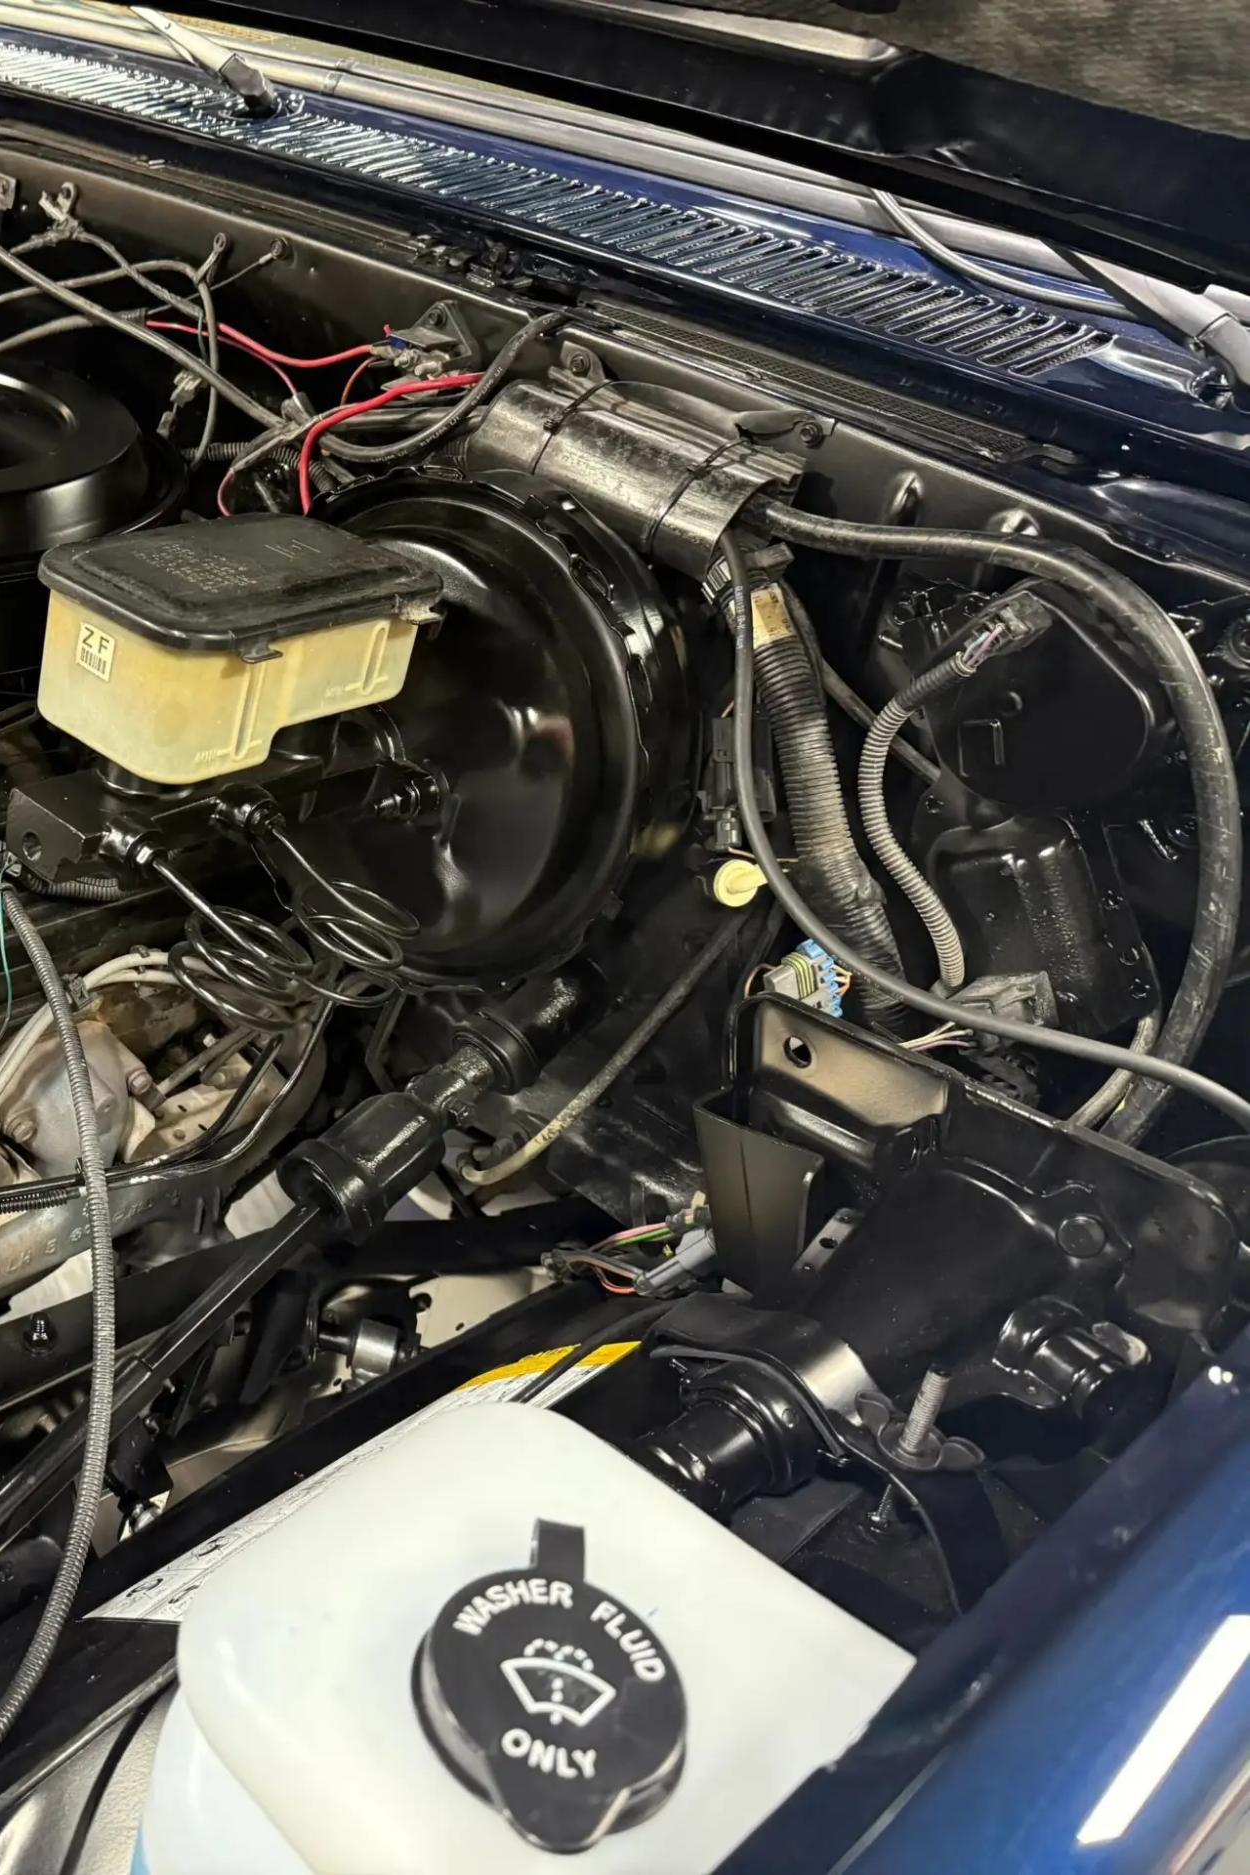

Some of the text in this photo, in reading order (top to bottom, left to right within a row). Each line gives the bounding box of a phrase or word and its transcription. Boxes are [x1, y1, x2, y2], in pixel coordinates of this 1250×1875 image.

[452, 1578, 666, 1682] WASHER FLUID
[501, 1727, 597, 1779] ONLY
